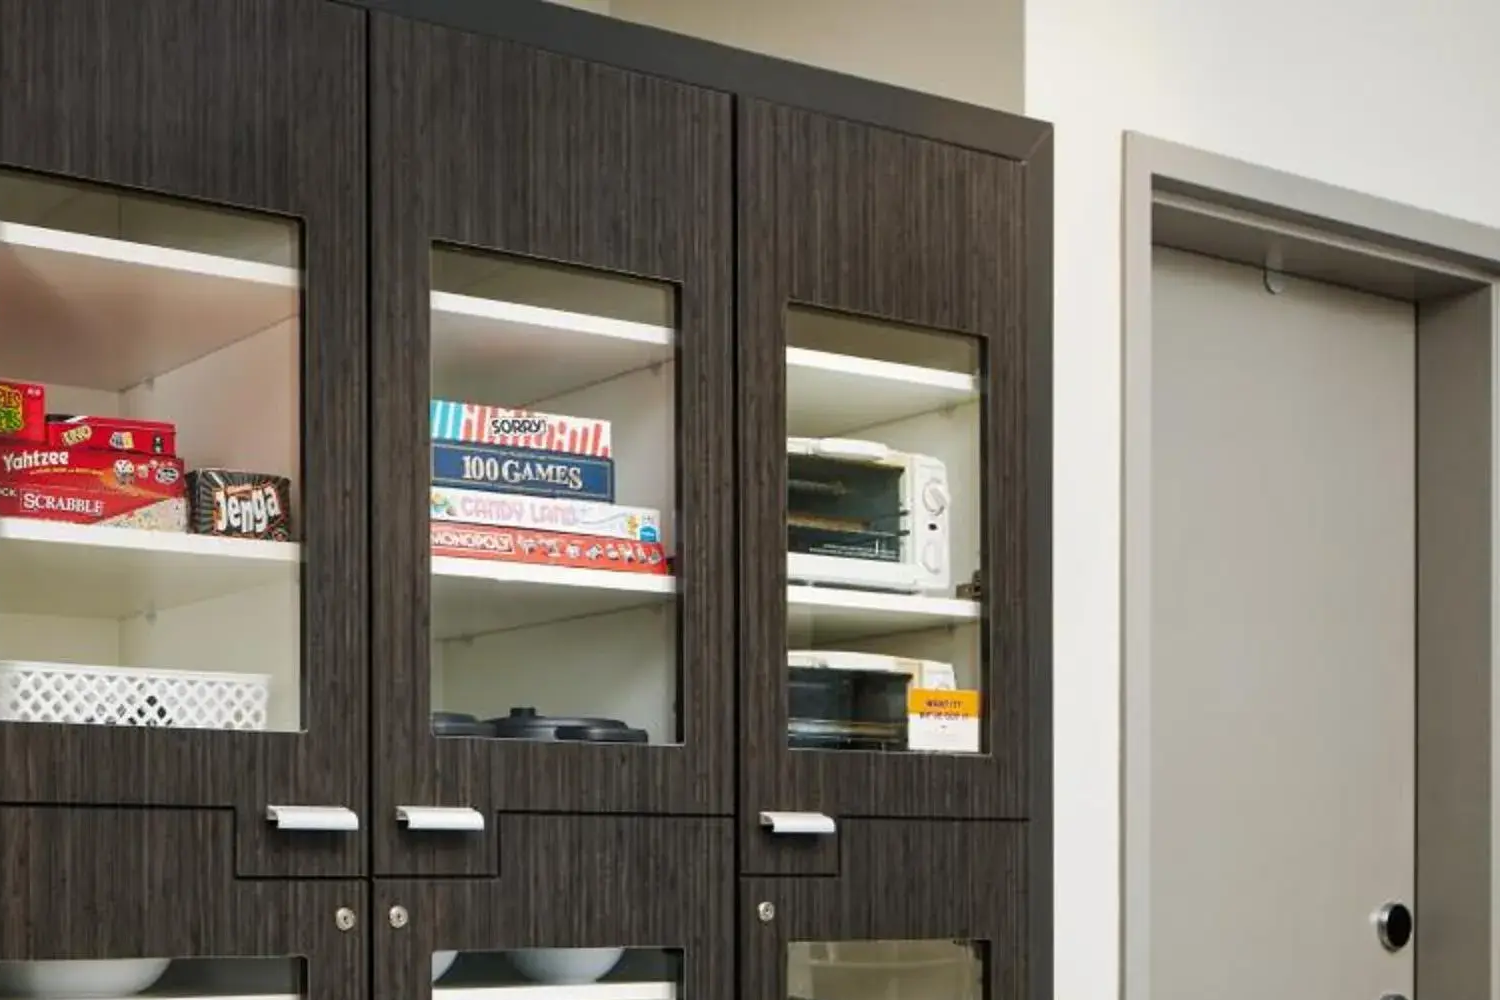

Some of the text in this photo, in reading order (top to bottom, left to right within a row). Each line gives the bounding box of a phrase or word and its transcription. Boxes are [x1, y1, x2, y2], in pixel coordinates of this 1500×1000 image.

[3, 450, 69, 472] Yahtzee
[462, 456, 582, 490] 100 GAMES
[23, 492, 104, 515] SCRABBLE
[215, 485, 281, 534] Jenga
